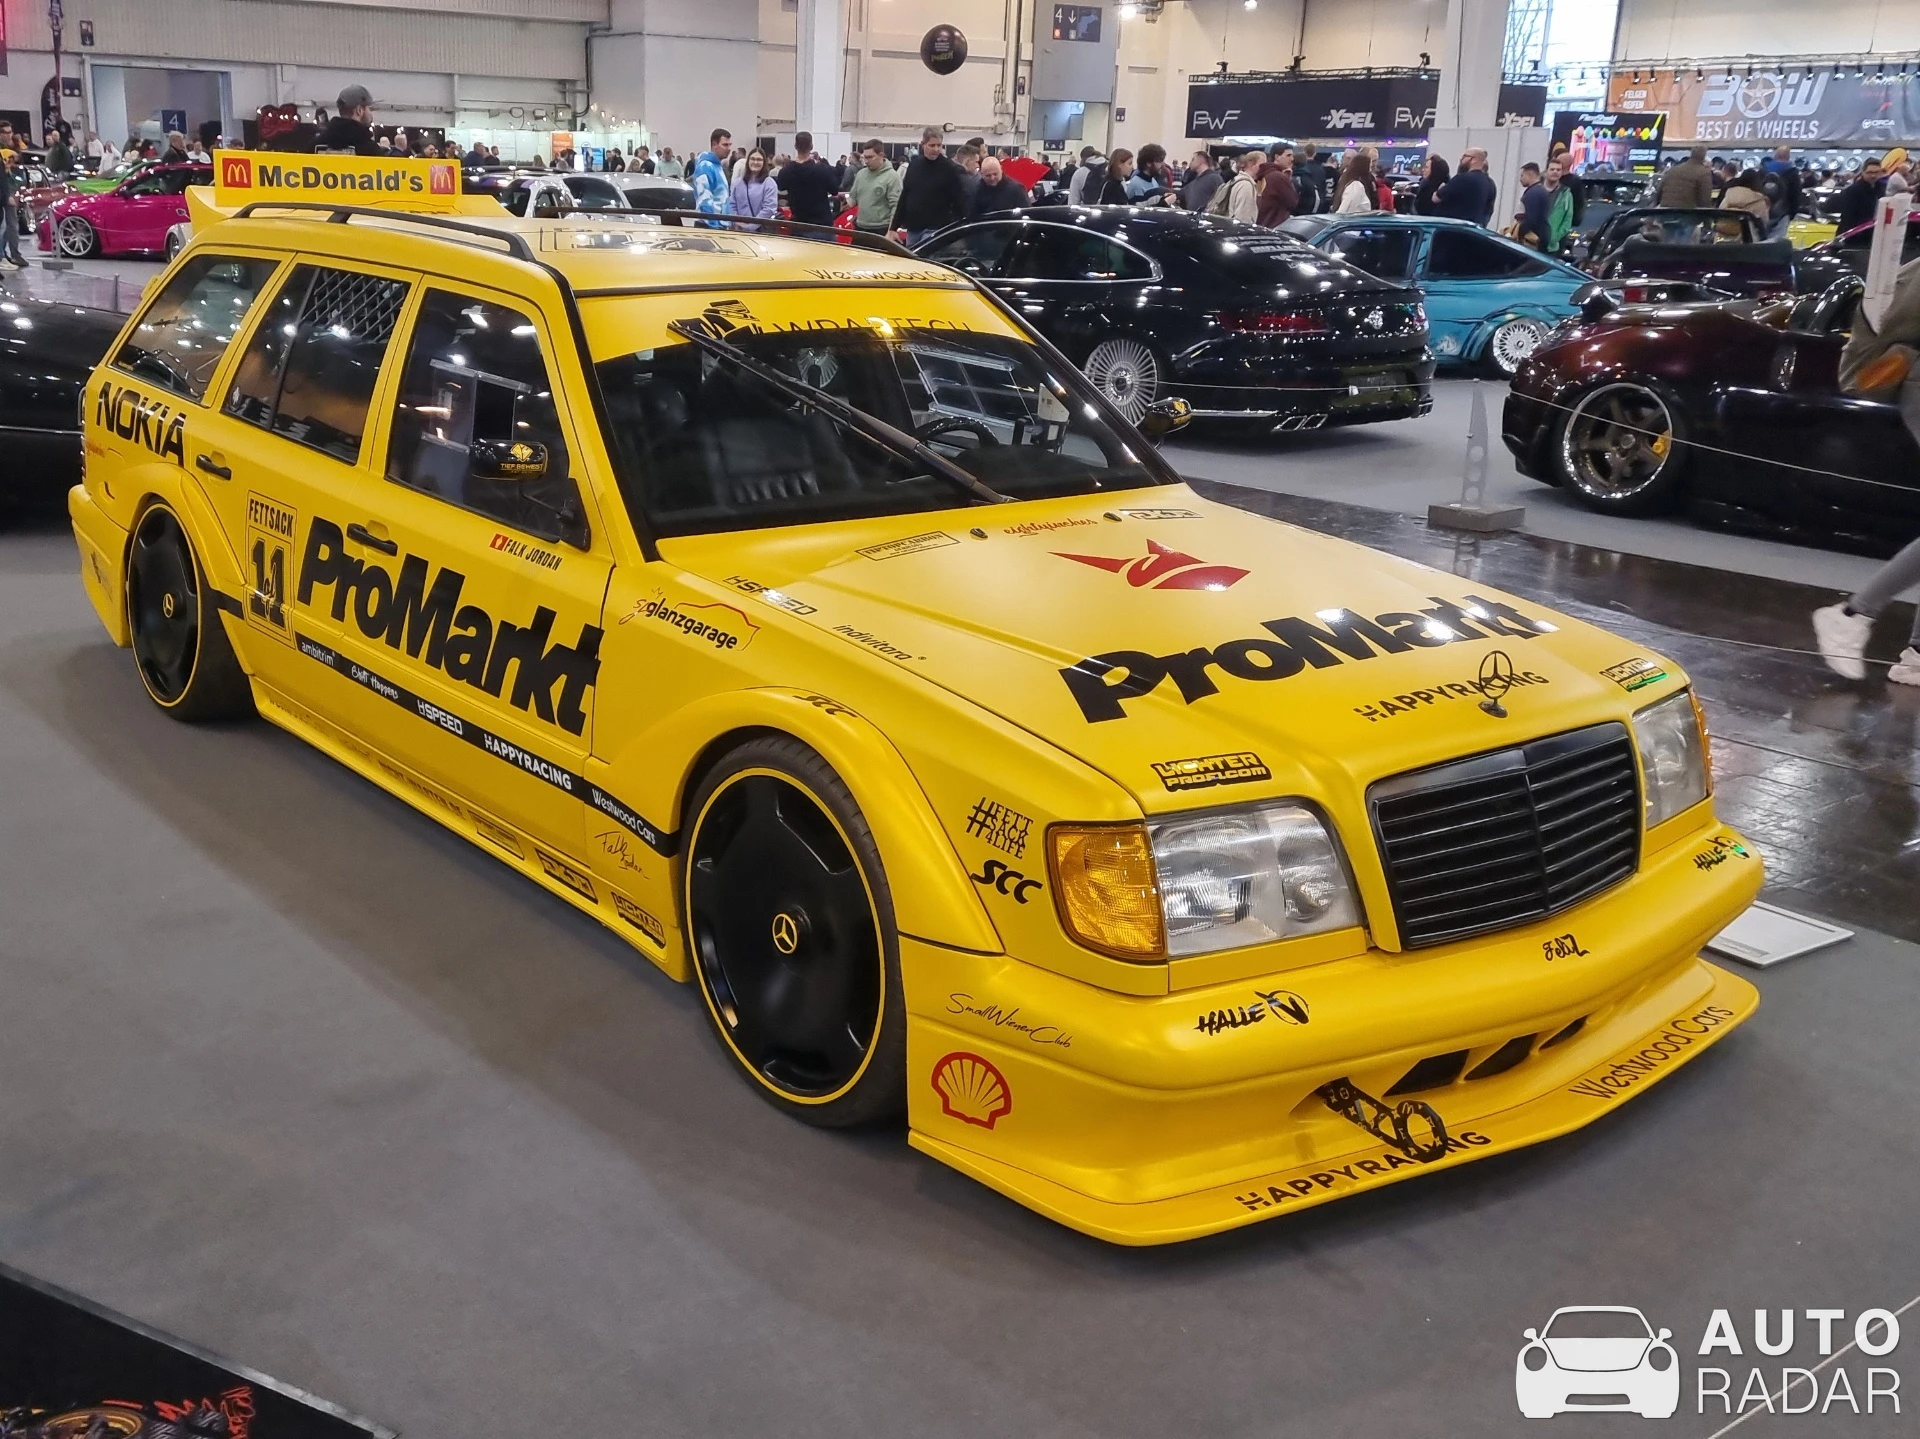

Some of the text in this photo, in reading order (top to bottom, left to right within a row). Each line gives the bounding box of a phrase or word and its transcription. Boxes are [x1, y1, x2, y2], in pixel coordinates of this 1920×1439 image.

[1055, 7, 1063, 24] 4
[169, 114, 178, 130] 4
[1193, 110, 1241, 130] PWF
[1326, 109, 1375, 129] XPEL
[1696, 120, 1820, 140] BEST OF WHEELS
[258, 164, 423, 192] McDonald's
[96, 381, 187, 469] NOKIA
[249, 498, 294, 538] FETTSACK
[503, 538, 563, 572] FALK JORDAN
[296, 515, 606, 738] ProMarkt
[646, 597, 738, 650] glanzgarage
[1058, 594, 1561, 724] ProMarkt
[1154, 753, 1261, 778] LICHTER
[483, 733, 572, 790] HAPPYRACING
[592, 788, 636, 831] Westwood
[636, 819, 657, 845] Cars
[970, 859, 1044, 905] SCC
[1193, 1001, 1267, 1036] HALLE
[1568, 1006, 1734, 1099] Westwood Cars
